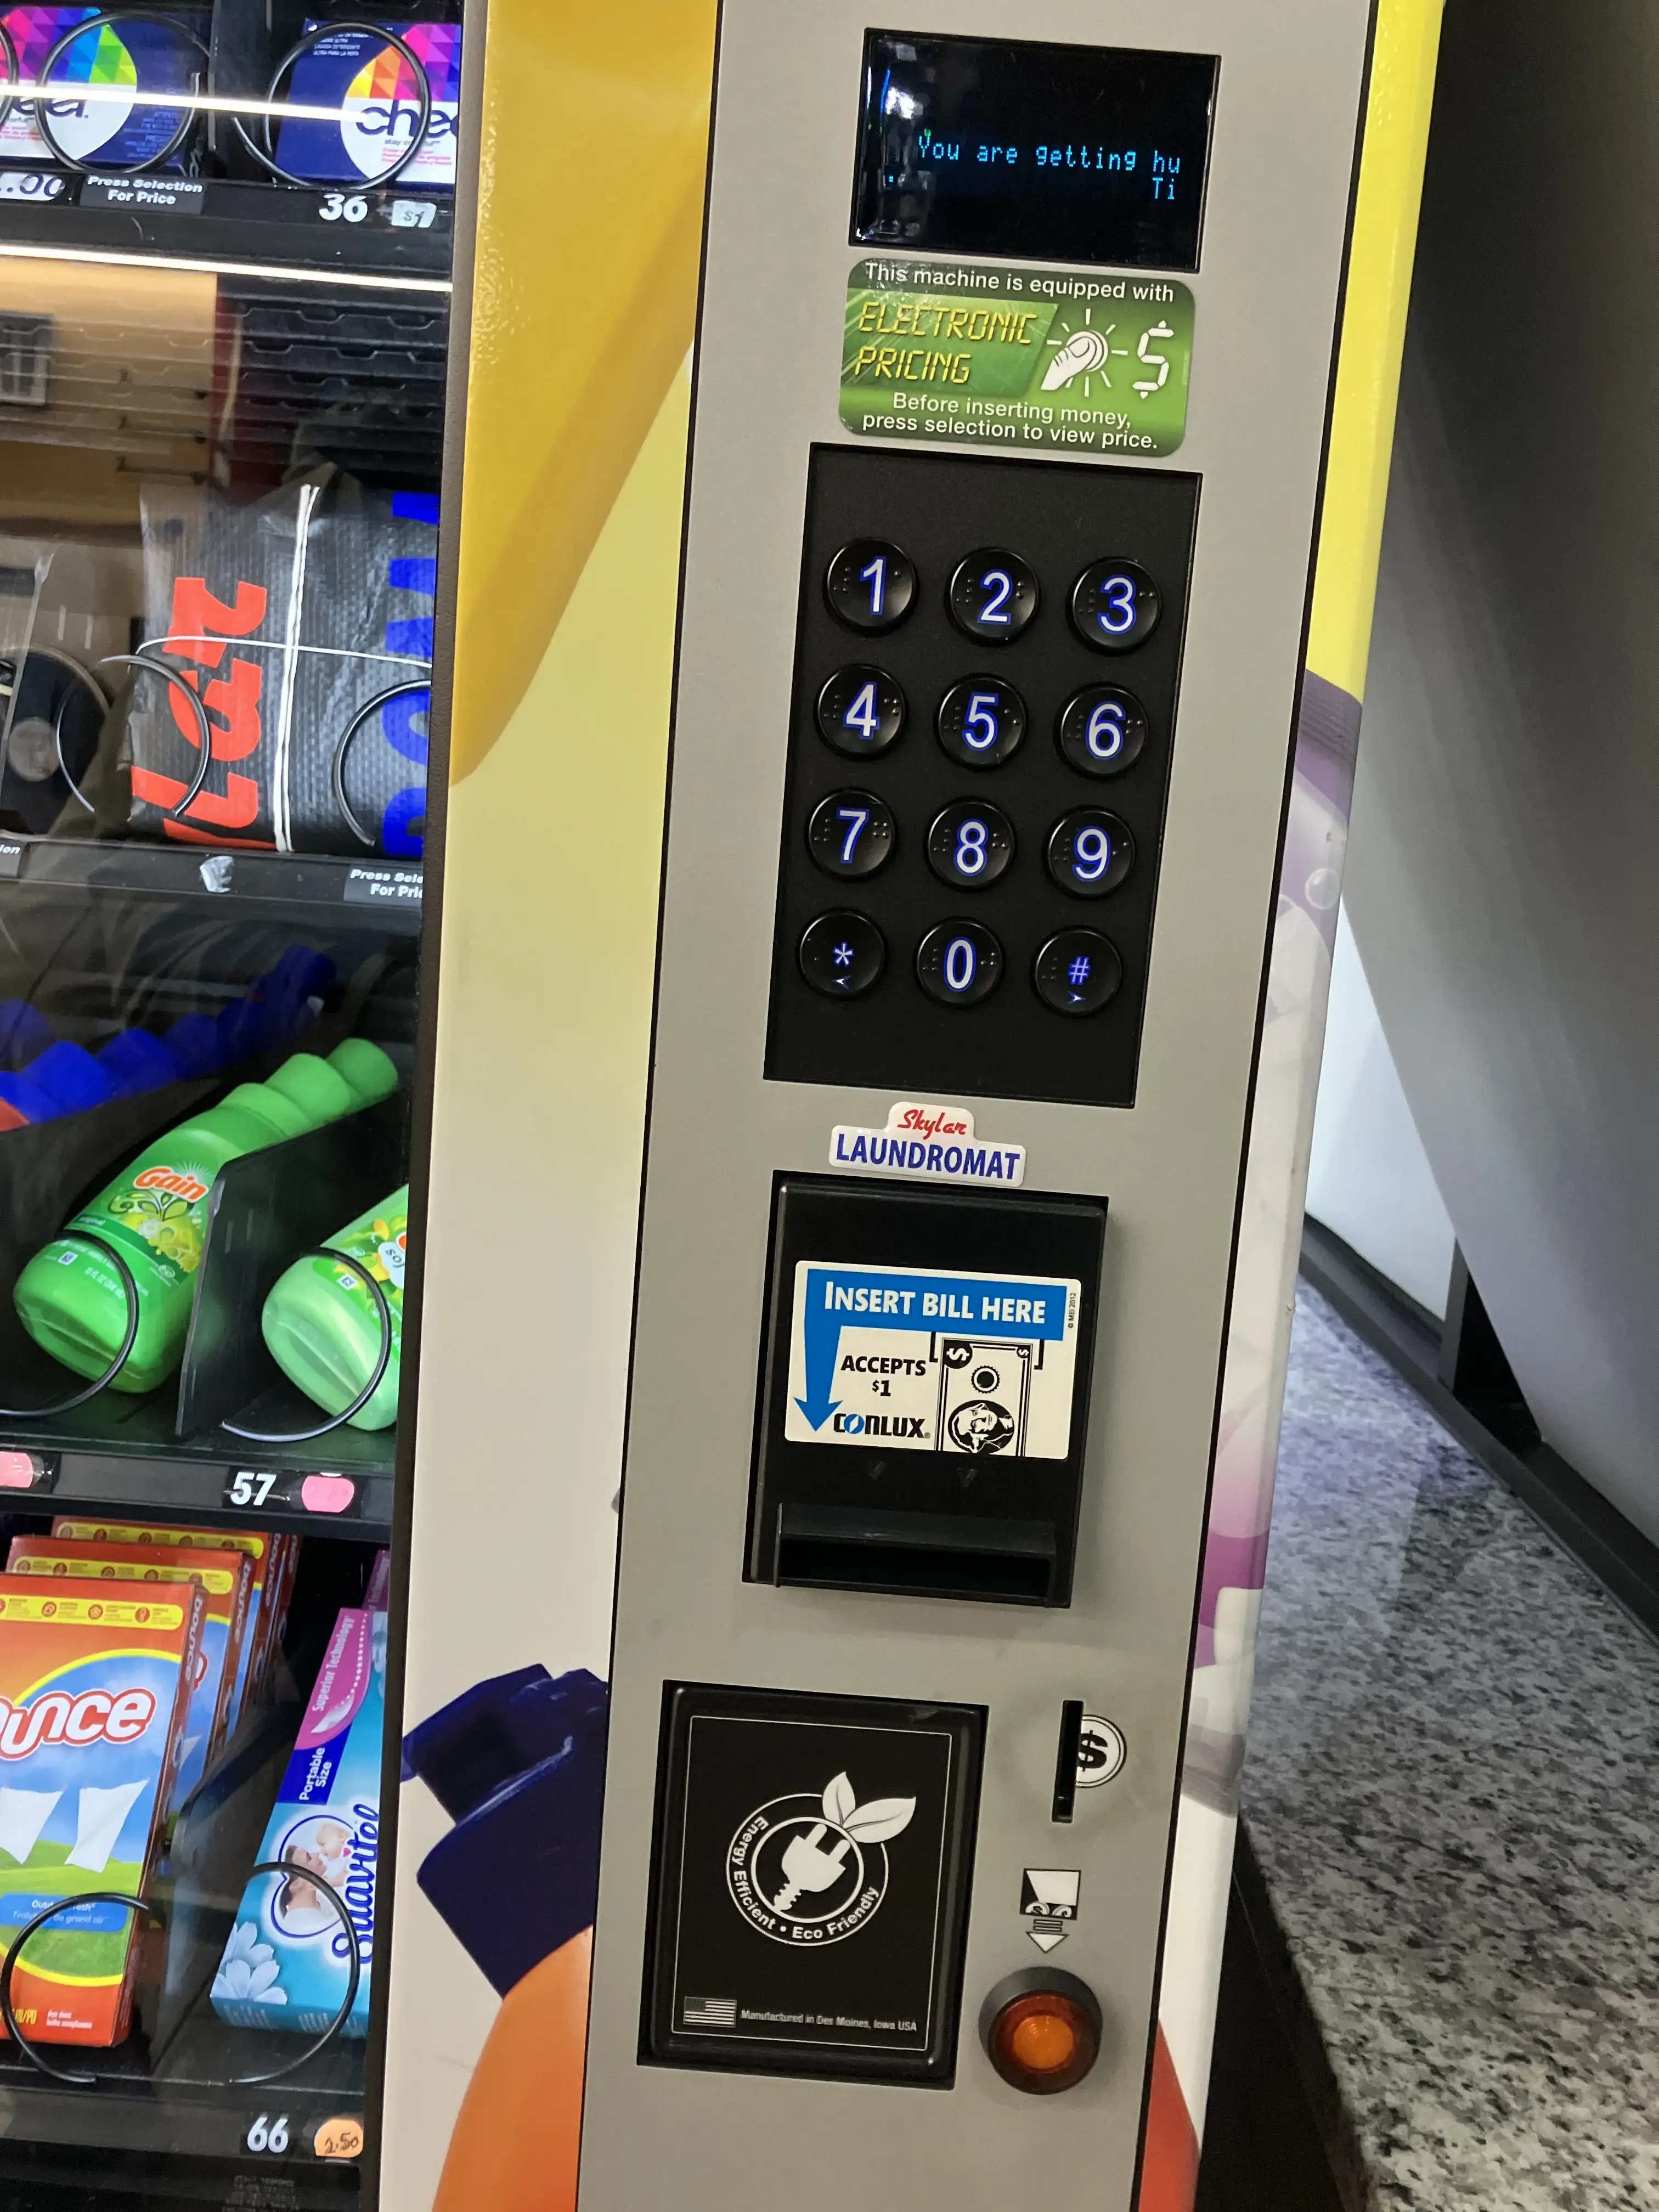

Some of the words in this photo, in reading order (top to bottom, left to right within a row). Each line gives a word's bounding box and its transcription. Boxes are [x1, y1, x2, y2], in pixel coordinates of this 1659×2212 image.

[356, 99, 458, 138] che
[918, 136, 959, 161] You
[977, 145, 1018, 164] are
[1036, 145, 1136, 172] getting
[1152, 150, 1181, 174] hu
[0, 173, 65, 197] .00
[87, 175, 129, 187] Press
[133, 179, 203, 193] Selection
[108, 189, 134, 201] For
[137, 192, 176, 205] Price
[1152, 177, 1175, 200] Ti
[319, 193, 368, 222] 36
[866, 263, 908, 283] This
[913, 268, 1000, 290] machine
[1006, 274, 1023, 291] is
[1030, 277, 1125, 300] equipped
[1133, 283, 1175, 302] with
[859, 301, 1037, 345] ELECTRONIC
[855, 346, 972, 383] PRICING
[893, 392, 958, 414] Before
[966, 398, 1054, 424] inserting
[1060, 407, 1131, 429] money,
[863, 414, 917, 432] press
[924, 418, 1015, 439] selection
[1023, 424, 1042, 440] to
[1049, 426, 1094, 444] view
[1102, 430, 1158, 449] price.
[860, 556, 887, 615] 1
[977, 569, 1013, 625] 2
[1098, 575, 1136, 634] 3
[843, 682, 878, 739] 4
[962, 693, 998, 751] 5
[1085, 701, 1126, 759] 6
[837, 808, 869, 864] 7
[955, 819, 988, 876] 8
[1072, 826, 1109, 881] 9
[349, 869, 391, 881] Press
[370, 883, 395, 896] For
[944, 937, 976, 991] 0
[1069, 956, 1090, 985] #
[897, 1109, 967, 1140] Skylar
[836, 1133, 1020, 1180] LAUNDROMAT
[134, 1167, 208, 1201] Gain
[825, 1281, 916, 1315] INSERT
[922, 1293, 974, 1319] BILL
[981, 1297, 1046, 1323] HERE
[841, 1355, 926, 1376] ACCEPTS
[872, 1379, 891, 1397] $1
[229, 1472, 276, 1506] 57
[185, 1594, 203, 1684] bounce
[312, 1668, 335, 1712] Superior
[326, 1615, 355, 1669] Technology
[0, 1689, 155, 1759] unce
[298, 1747, 325, 1801] Portable
[315, 1761, 332, 1788] Size
[732, 1816, 769, 1865] Energy
[332, 1804, 379, 1964] Suavitel
[734, 1870, 776, 1930] Efficient
[66, 1915, 91, 1925] grand
[827, 1886, 879, 1936] Friendly
[792, 1926, 823, 1939] Eco
[741, 2010, 803, 2023] Manufactured
[805, 2015, 815, 2024] in
[816, 2015, 833, 2025] Des
[836, 2016, 871, 2029] Moines,
[873, 2020, 895, 2029] Iowa
[898, 2021, 917, 2032] USA
[247, 2116, 289, 2153] 66
[324, 2132, 359, 2154] 2.50
